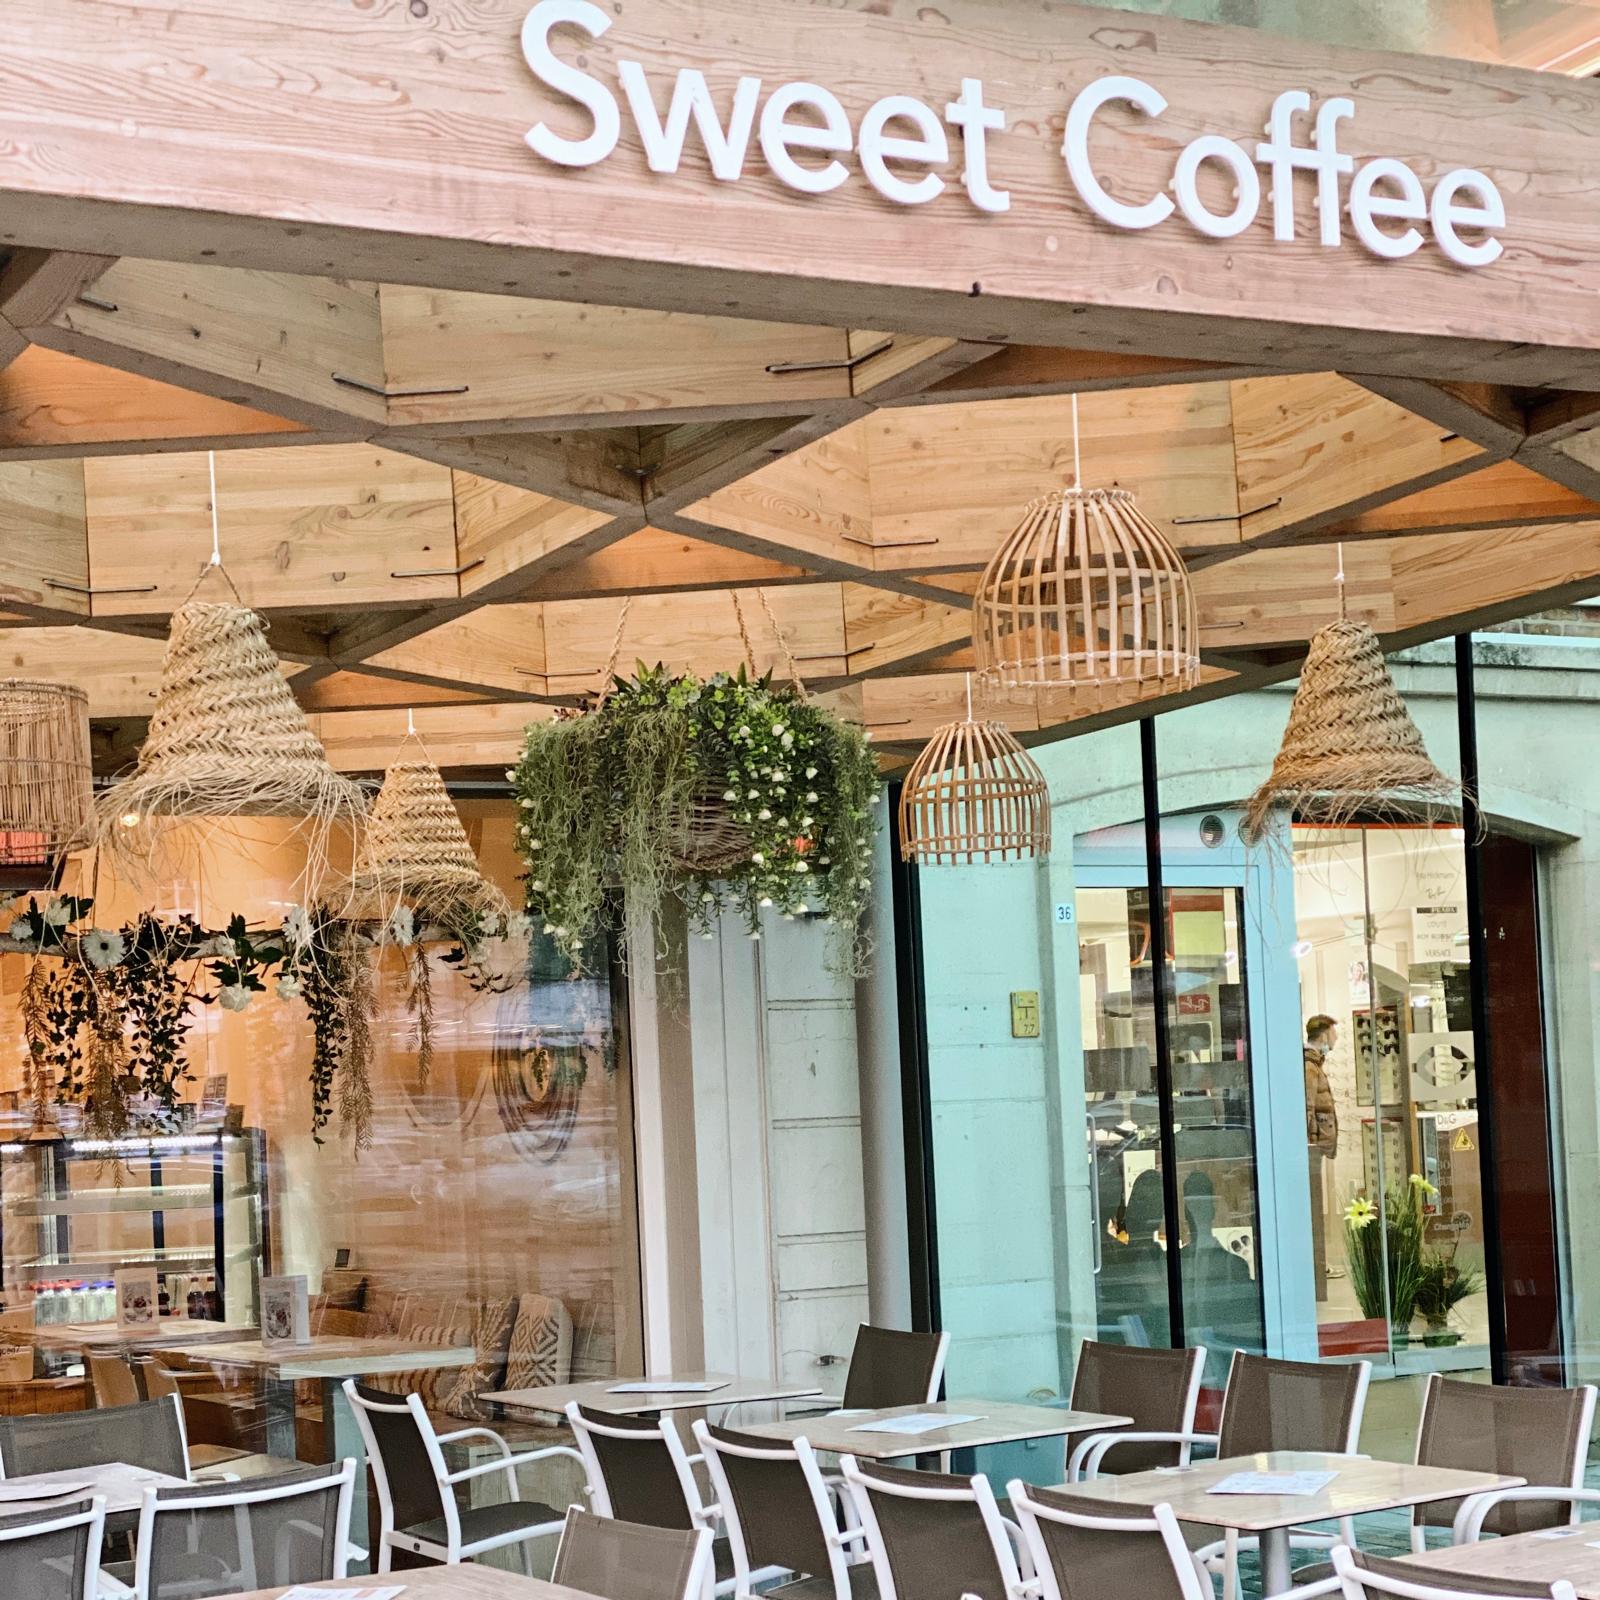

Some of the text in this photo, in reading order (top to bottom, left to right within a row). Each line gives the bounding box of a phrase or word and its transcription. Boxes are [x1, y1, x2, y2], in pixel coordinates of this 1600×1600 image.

[520, 0, 1507, 268] Sweet Coffee
[1058, 906, 1071, 920] 36
